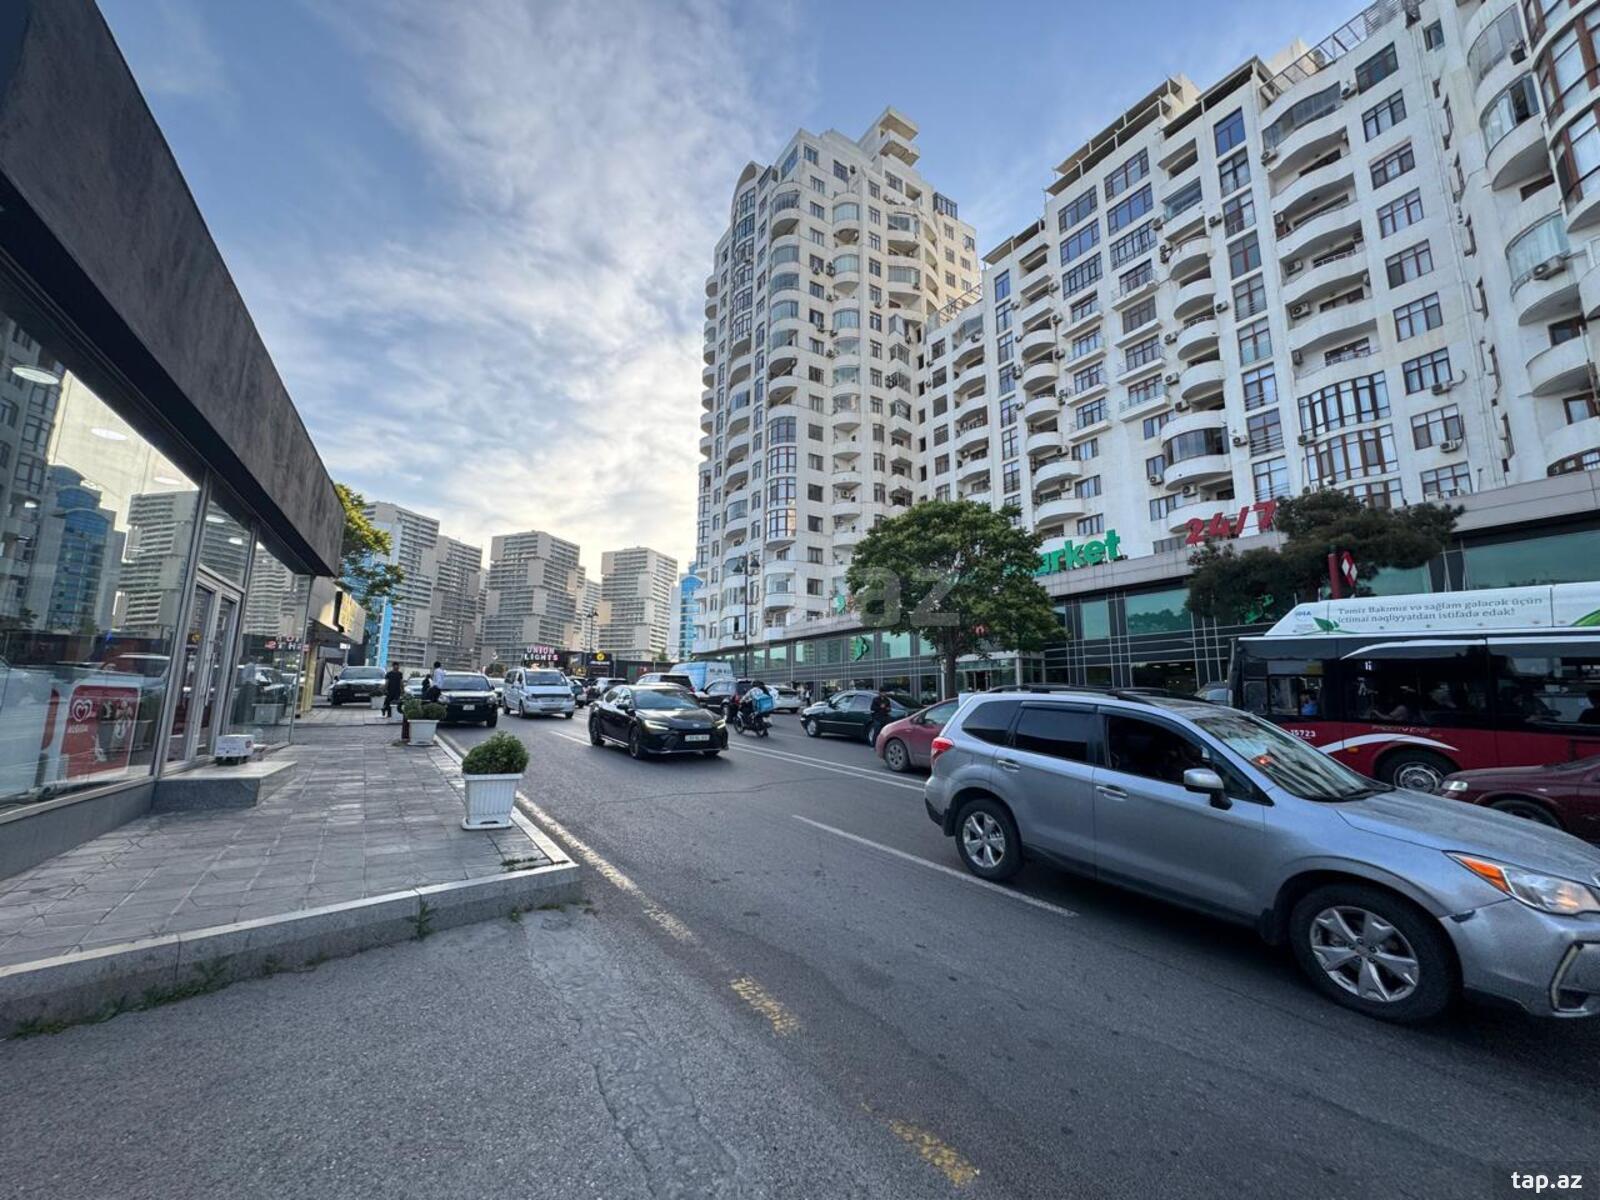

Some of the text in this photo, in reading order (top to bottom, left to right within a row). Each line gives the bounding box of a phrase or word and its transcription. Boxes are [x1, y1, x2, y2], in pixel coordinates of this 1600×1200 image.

[1184, 500, 1276, 545] 24/7
[1033, 528, 1120, 577] arket
[524, 653, 559, 661] LIGHTS
[526, 645, 556, 655] UNION
